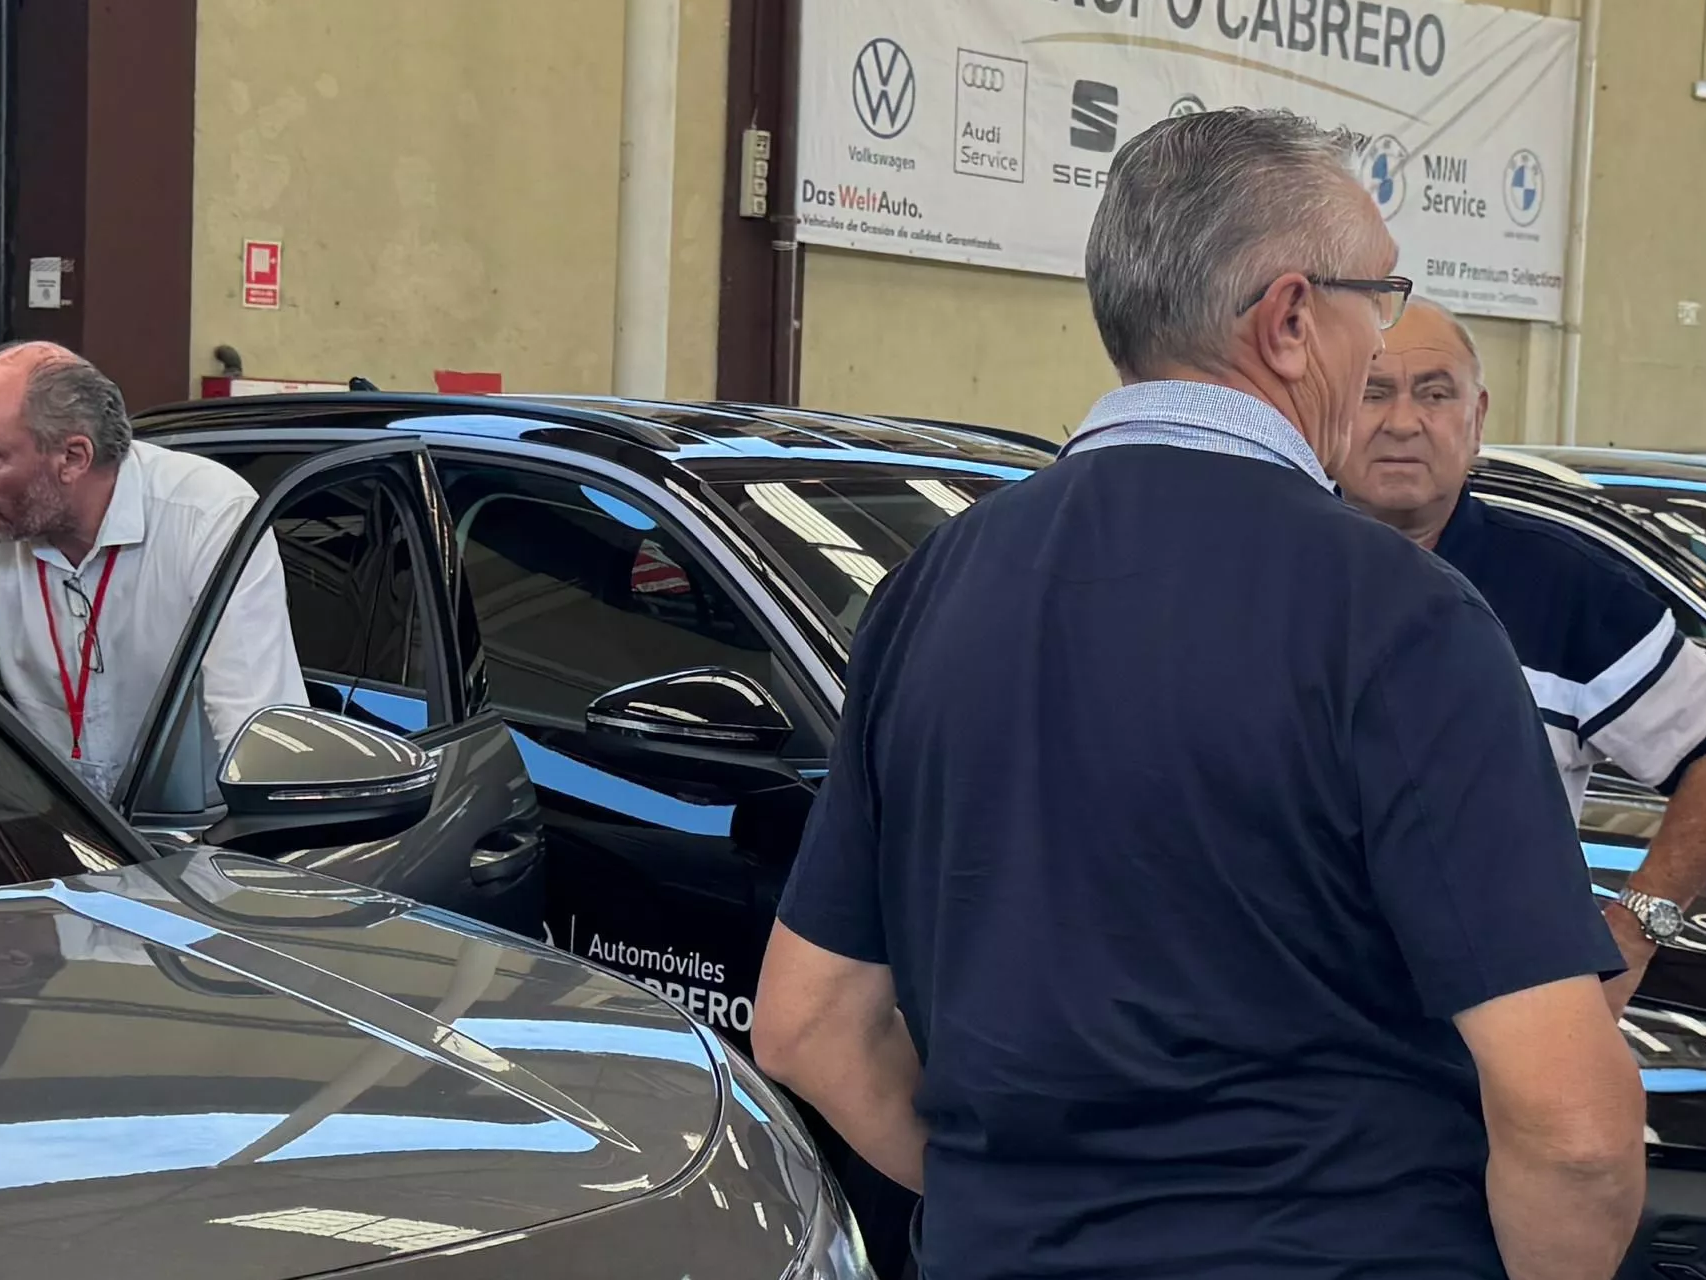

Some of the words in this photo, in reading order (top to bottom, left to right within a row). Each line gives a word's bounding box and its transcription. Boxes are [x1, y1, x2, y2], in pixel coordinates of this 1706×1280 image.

[961, 121, 1001, 145] Audi
[848, 145, 916, 172] Volkswagen
[960, 145, 1019, 172] Service
[1423, 154, 1467, 184] MINI
[1053, 164, 1110, 189] SEA
[803, 179, 836, 207] Das
[1421, 185, 1487, 218] Service
[1426, 258, 1456, 278] BMW
[1459, 262, 1509, 284] Premium
[1511, 266, 1563, 291] Selection
[588, 933, 725, 984] Automóviles
